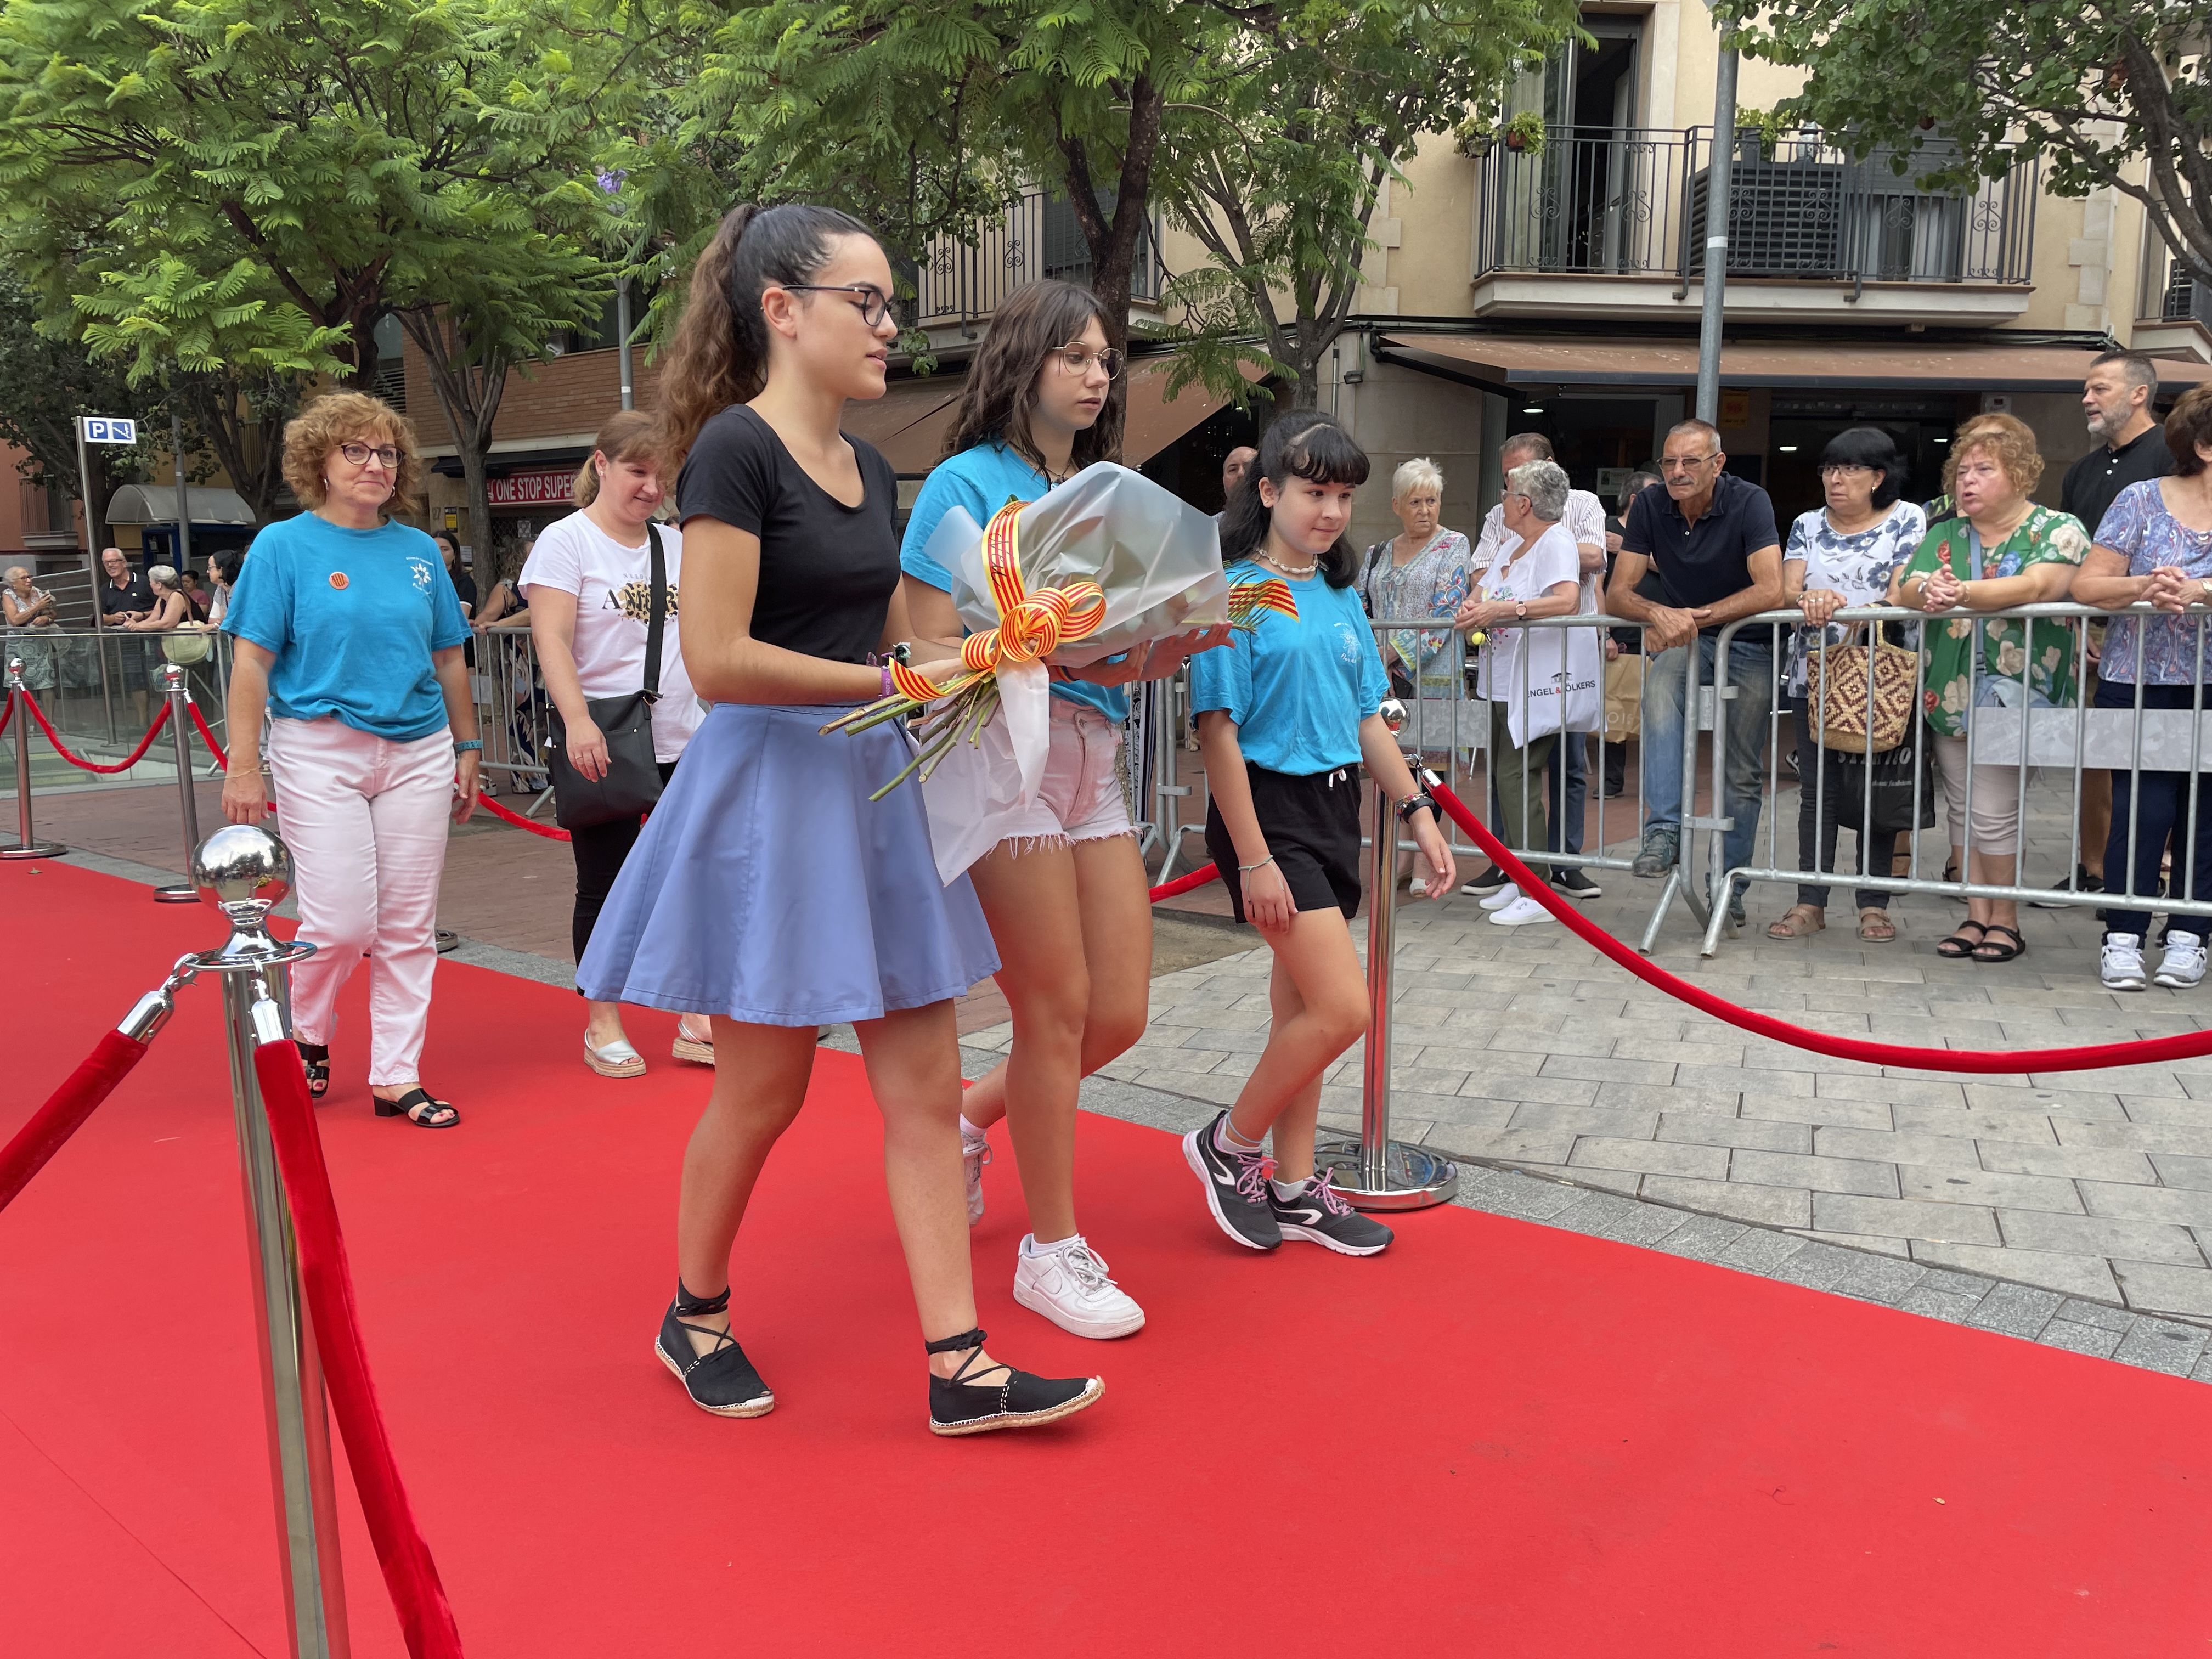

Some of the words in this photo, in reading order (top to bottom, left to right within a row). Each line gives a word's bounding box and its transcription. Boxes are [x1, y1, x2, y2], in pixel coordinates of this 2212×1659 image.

[92, 422, 105, 438] P
[496, 478, 516, 501] ONE
[517, 476, 542, 500] STOP
[1565, 680, 1596, 692] ÖLKERS
